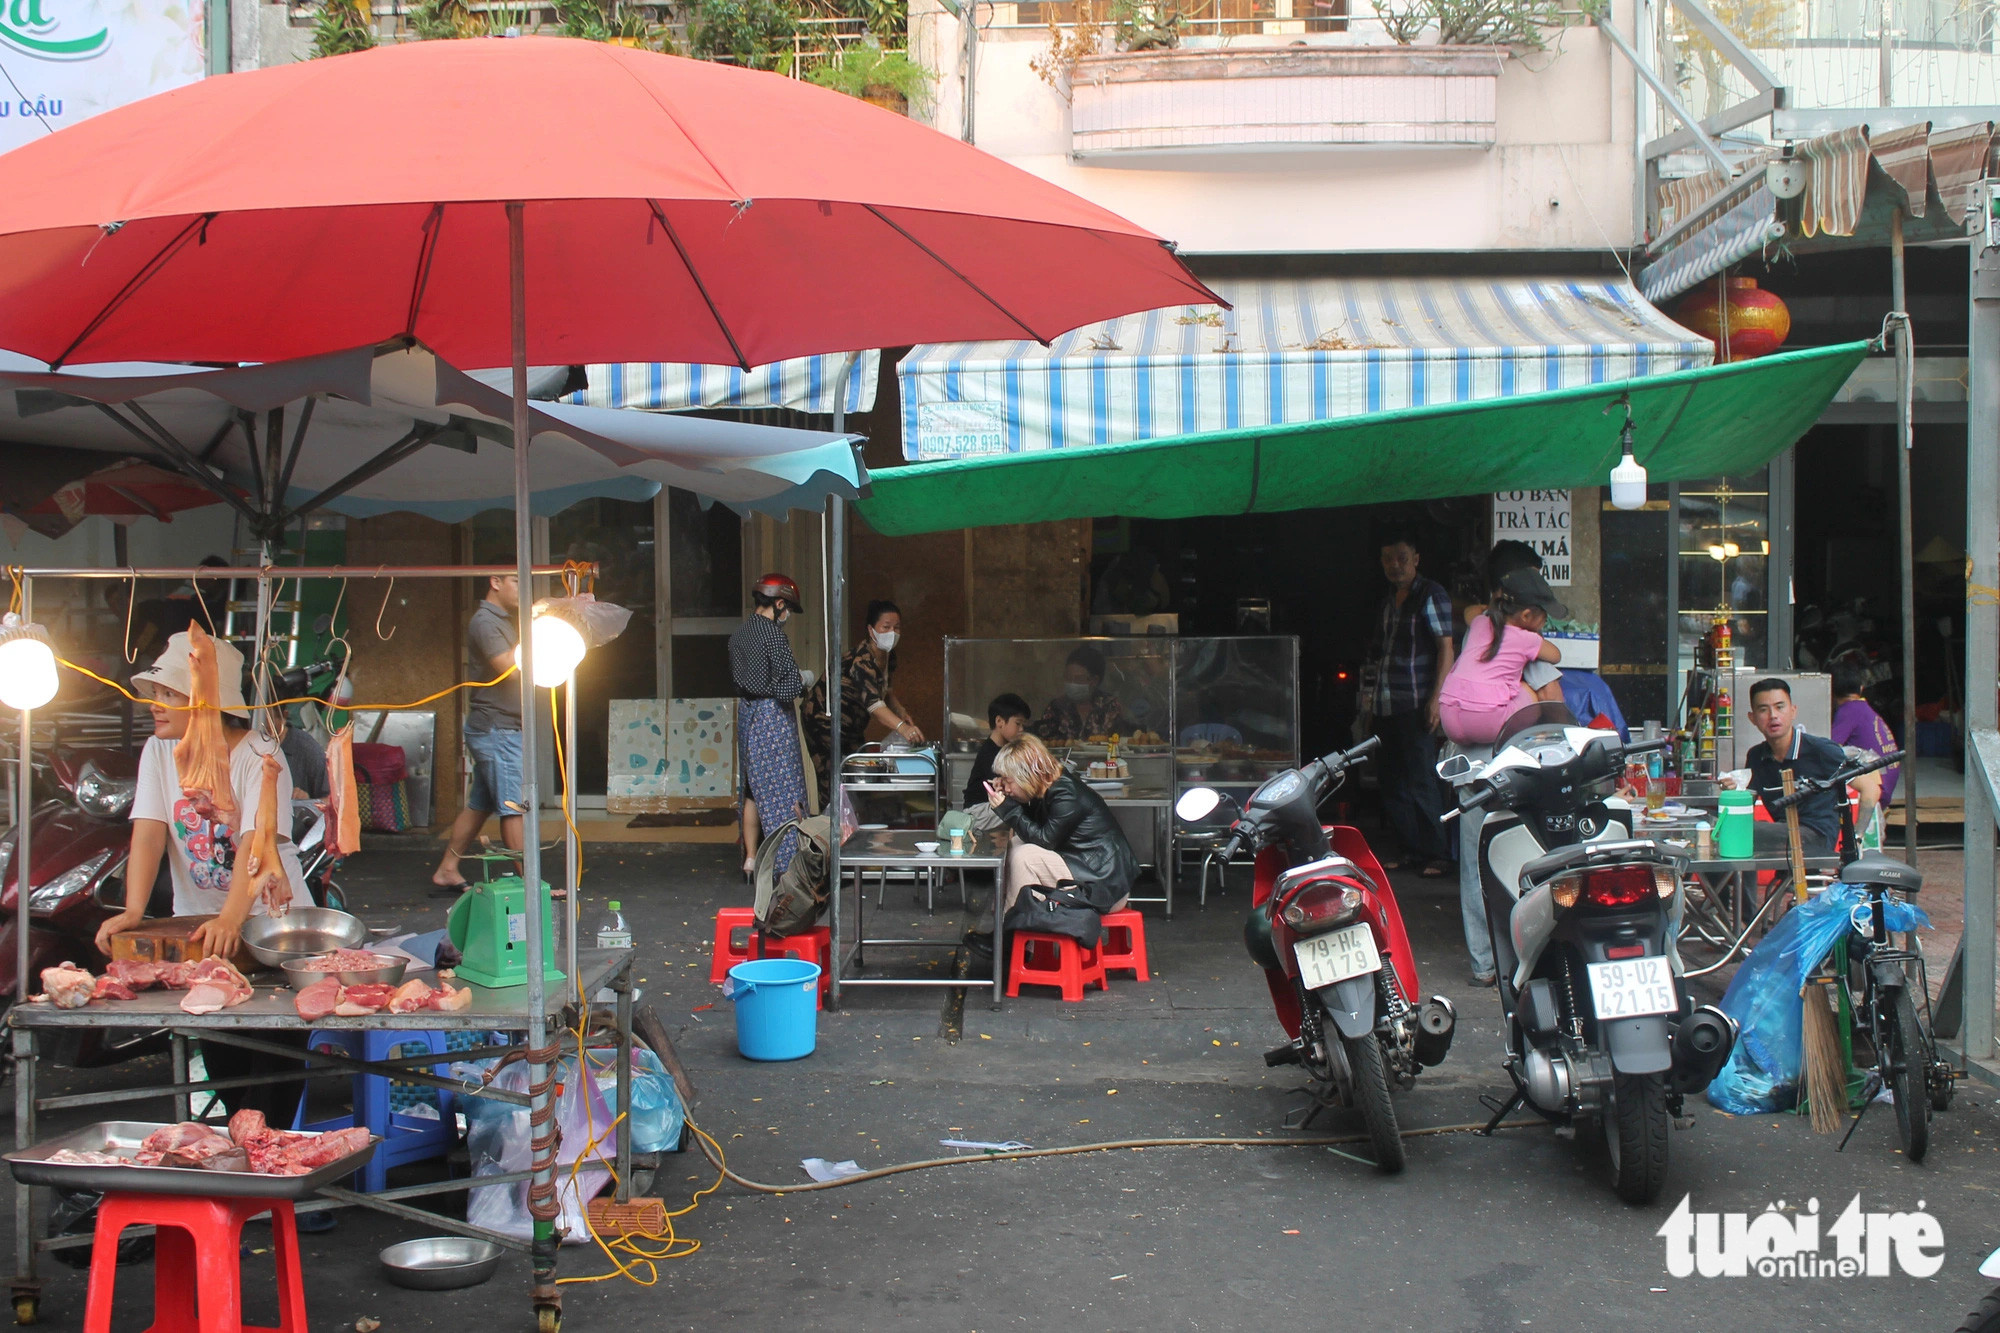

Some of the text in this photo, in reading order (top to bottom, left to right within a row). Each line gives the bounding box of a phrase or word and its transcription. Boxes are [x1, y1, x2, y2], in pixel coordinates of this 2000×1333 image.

[1496, 506, 1570, 529] TRÀ TẮC
[1541, 535, 1569, 556] MÁ
[1541, 561, 1570, 580] ÀNH
[1879, 870, 1901, 879] AKAMA
[1306, 930, 1362, 962] 79-H4
[1312, 950, 1368, 982] 1179
[1599, 961, 1661, 989] 59-U2
[1600, 986, 1671, 1016] 421.15
